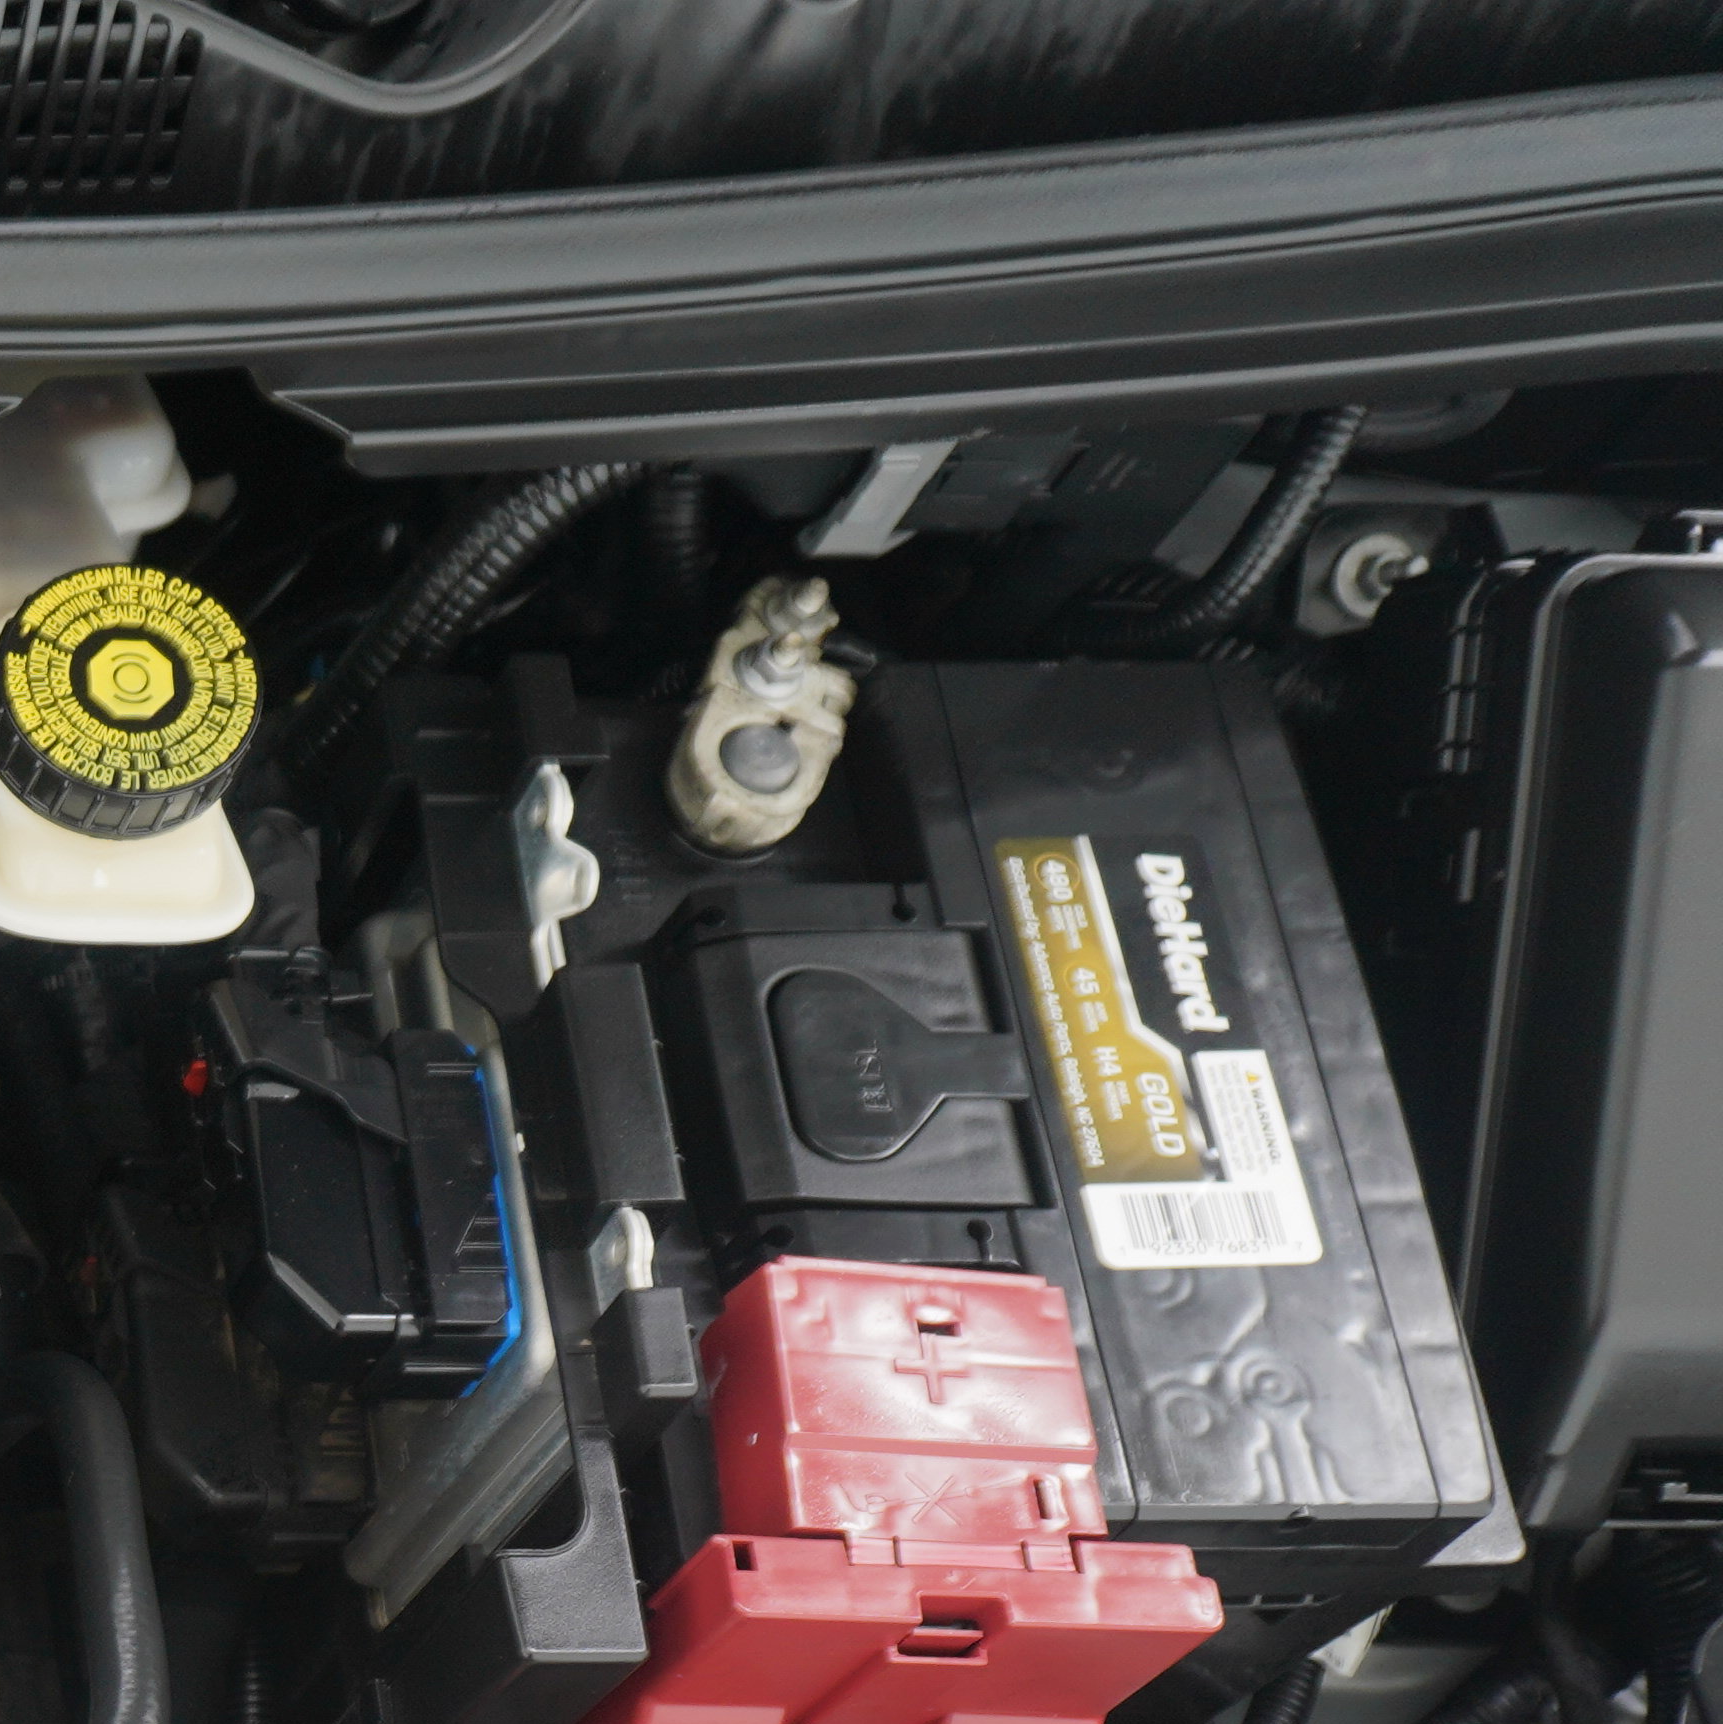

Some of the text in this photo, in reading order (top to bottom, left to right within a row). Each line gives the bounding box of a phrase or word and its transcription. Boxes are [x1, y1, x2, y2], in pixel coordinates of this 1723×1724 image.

[58, 616, 94, 650] FROM
[85, 610, 104, 629] A
[97, 604, 147, 625] SEALED
[107, 585, 139, 604] USE
[140, 587, 177, 613] ONLY
[170, 599, 201, 626] DOT
[194, 623, 230, 661] FLUID
[114, 566, 168, 591] FILLER
[165, 575, 205, 607] CAP
[195, 595, 247, 650] BEFORE
[29, 637, 54, 687] LIQUIDE
[213, 660, 235, 704] AVANT
[7, 651, 43, 730] REMPLISSAGE
[28, 724, 58, 750] DE
[38, 703, 103, 761] SEULEMENT
[55, 694, 128, 749] CONTENANT
[157, 688, 214, 747] PROVENANT
[206, 704, 232, 726] DE
[45, 741, 114, 786] BOUCHON
[120, 769, 140, 789] LE
[1134, 852, 1230, 1033] DieHard
[1073, 967, 1100, 996] 45
[1043, 991, 1063, 1021] Auto
[1093, 1046, 1122, 1076] H4
[1137, 1071, 1186, 1157] GOLD
